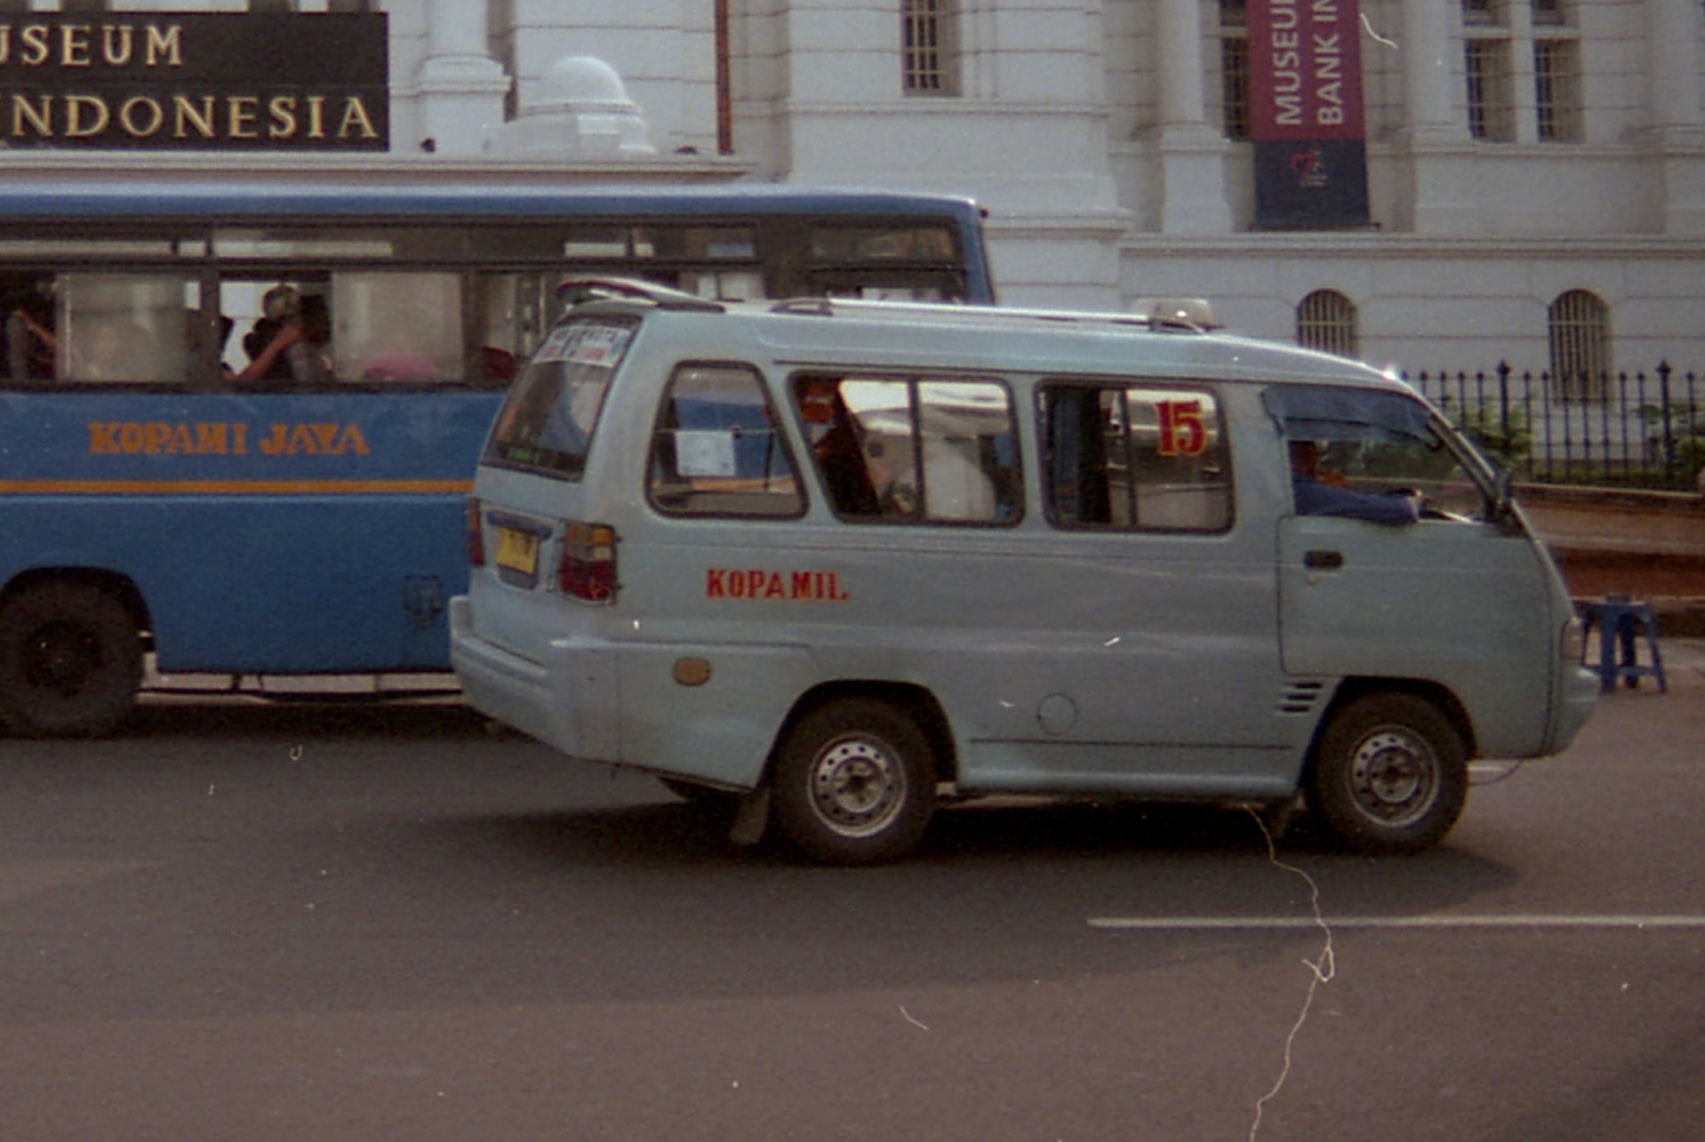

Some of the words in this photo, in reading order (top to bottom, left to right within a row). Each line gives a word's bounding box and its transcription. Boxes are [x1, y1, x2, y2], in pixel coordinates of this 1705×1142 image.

[1312, 34, 1343, 125] BANK
[88, 422, 246, 455] KOPAMI
[259, 423, 370, 455] JAYA
[1155, 398, 1207, 456] 15
